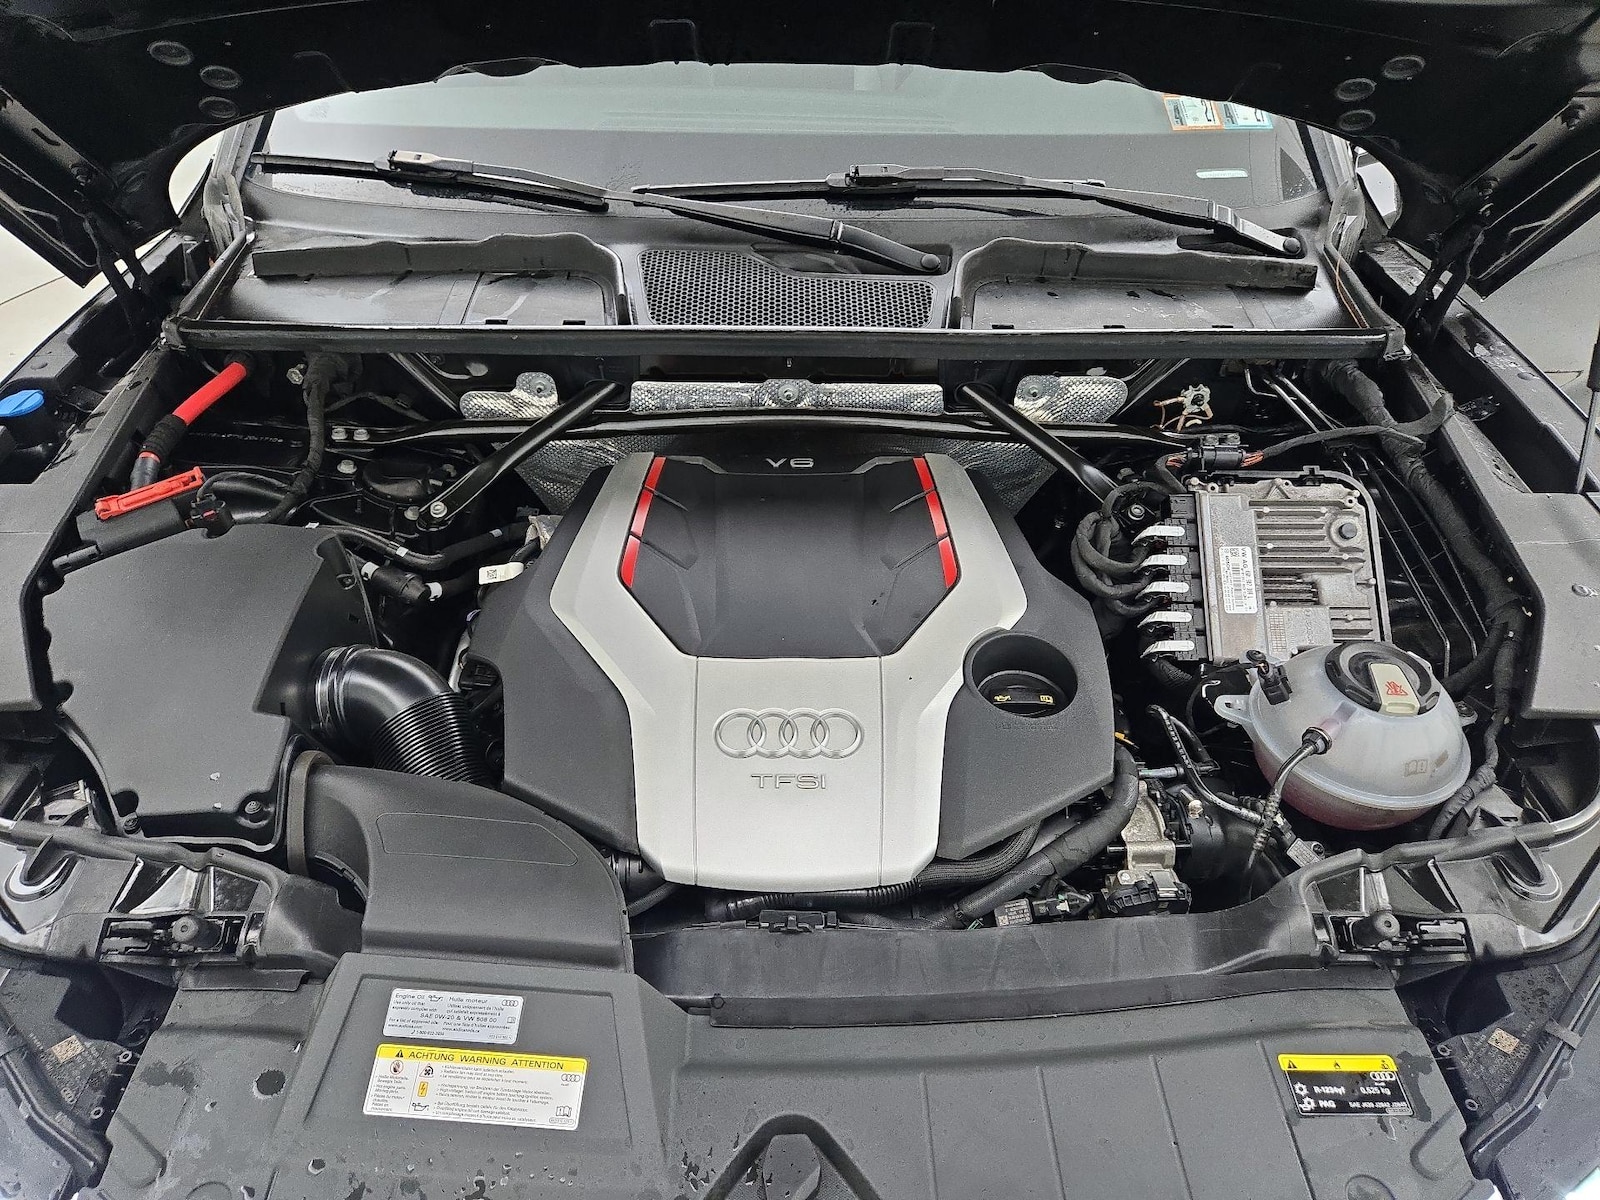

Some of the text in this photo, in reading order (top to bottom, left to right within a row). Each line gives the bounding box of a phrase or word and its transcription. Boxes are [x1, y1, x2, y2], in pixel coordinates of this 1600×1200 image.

[765, 457, 815, 468] V6
[750, 773, 826, 790] TFSI
[409, 1051, 564, 1070] ACHTUNG WARNING ATTENTION
[1313, 1086, 1347, 1095] R-1234yf
[1380, 1087, 1391, 1095] kg
[1318, 1100, 1336, 1108] PAG
